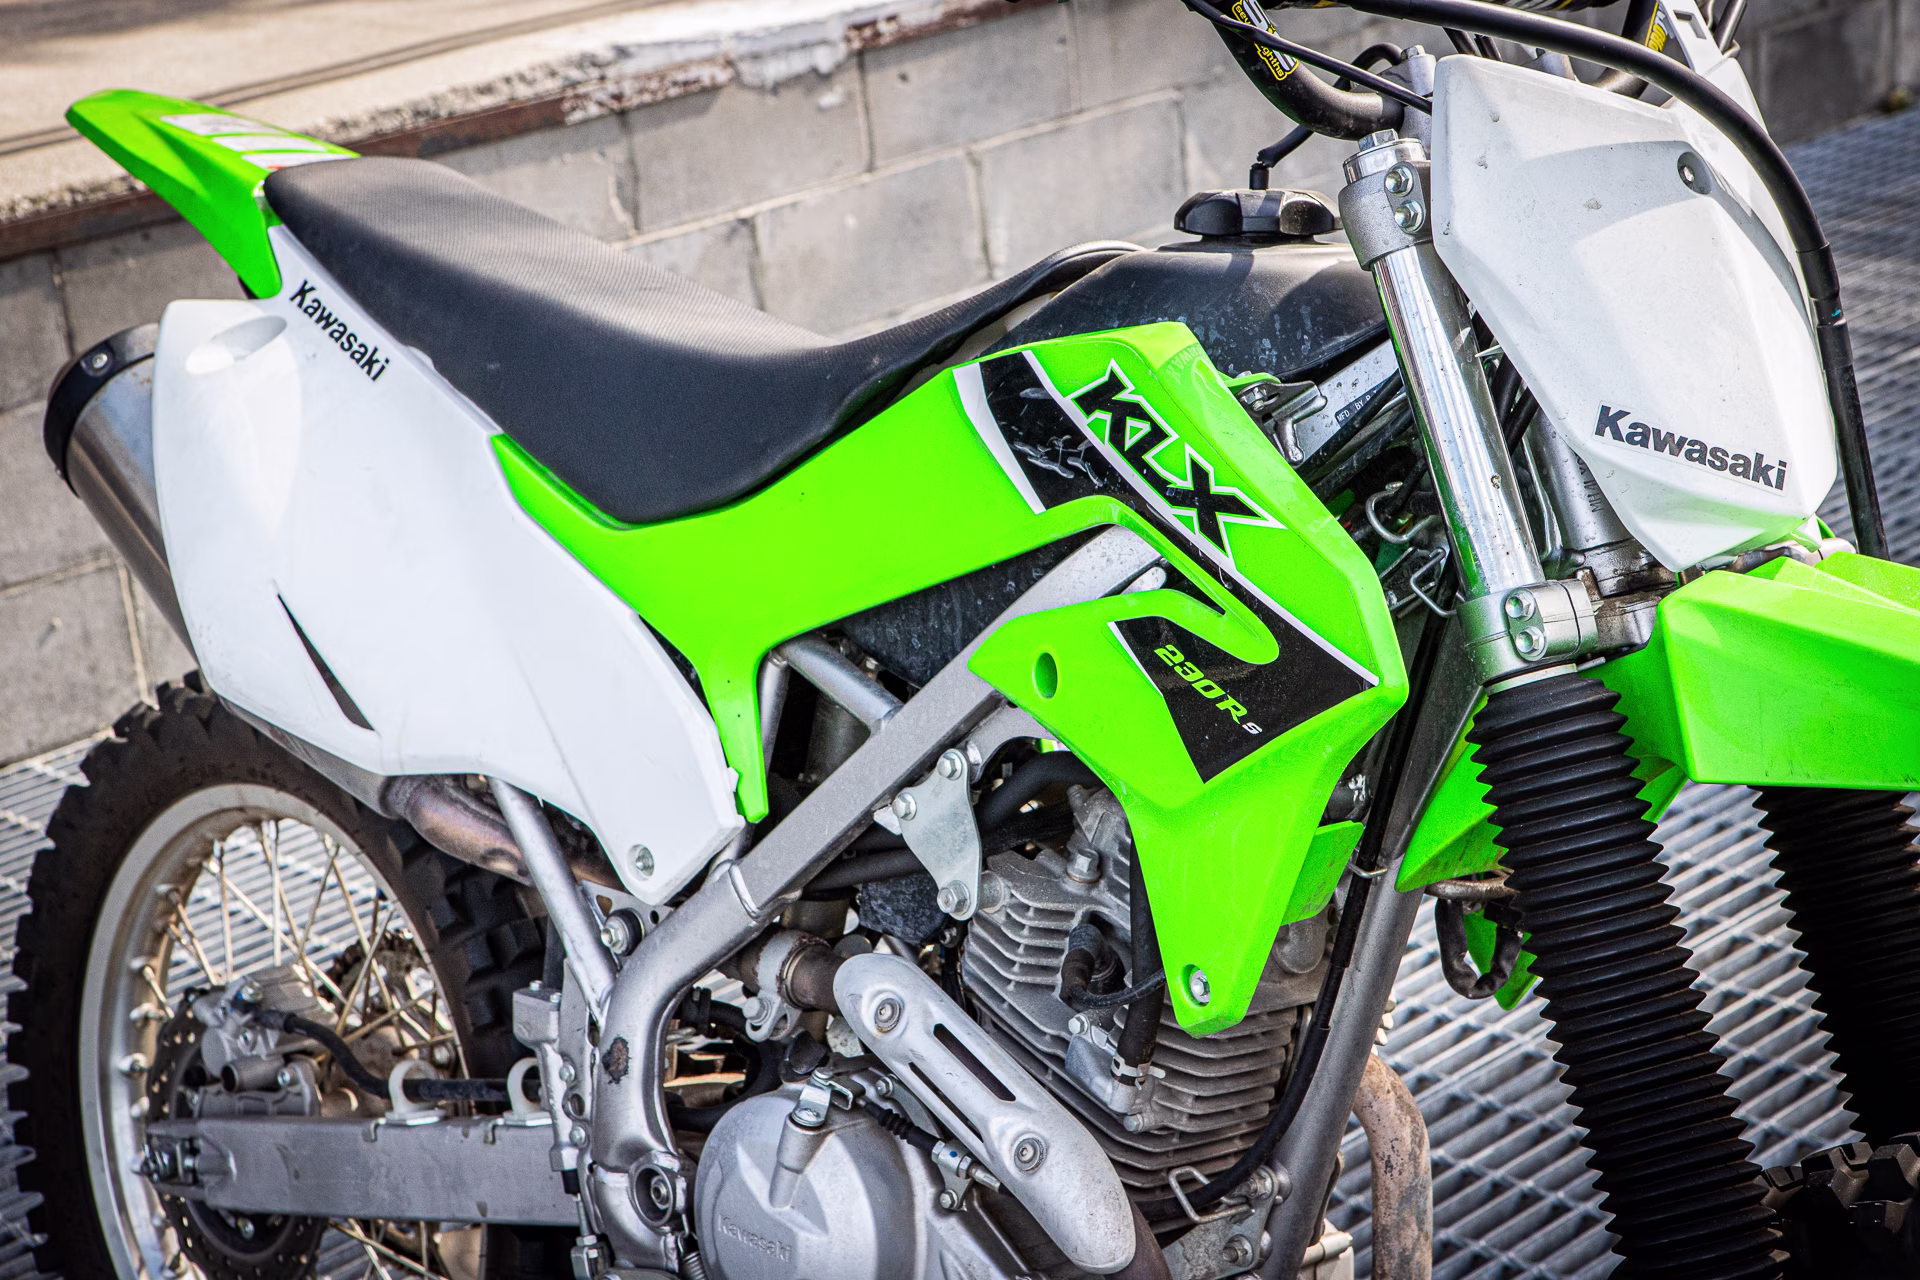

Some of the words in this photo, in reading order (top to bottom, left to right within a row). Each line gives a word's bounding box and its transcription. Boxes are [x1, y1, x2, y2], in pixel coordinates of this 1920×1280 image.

[289, 279, 390, 381] Kawasaki
[1354, 400, 1364, 410] BY
[1068, 360, 1282, 562] KLX
[1594, 405, 1788, 491] Kawasaki
[1153, 644, 1248, 725] 230R
[718, 1214, 791, 1262] Kawasaki
